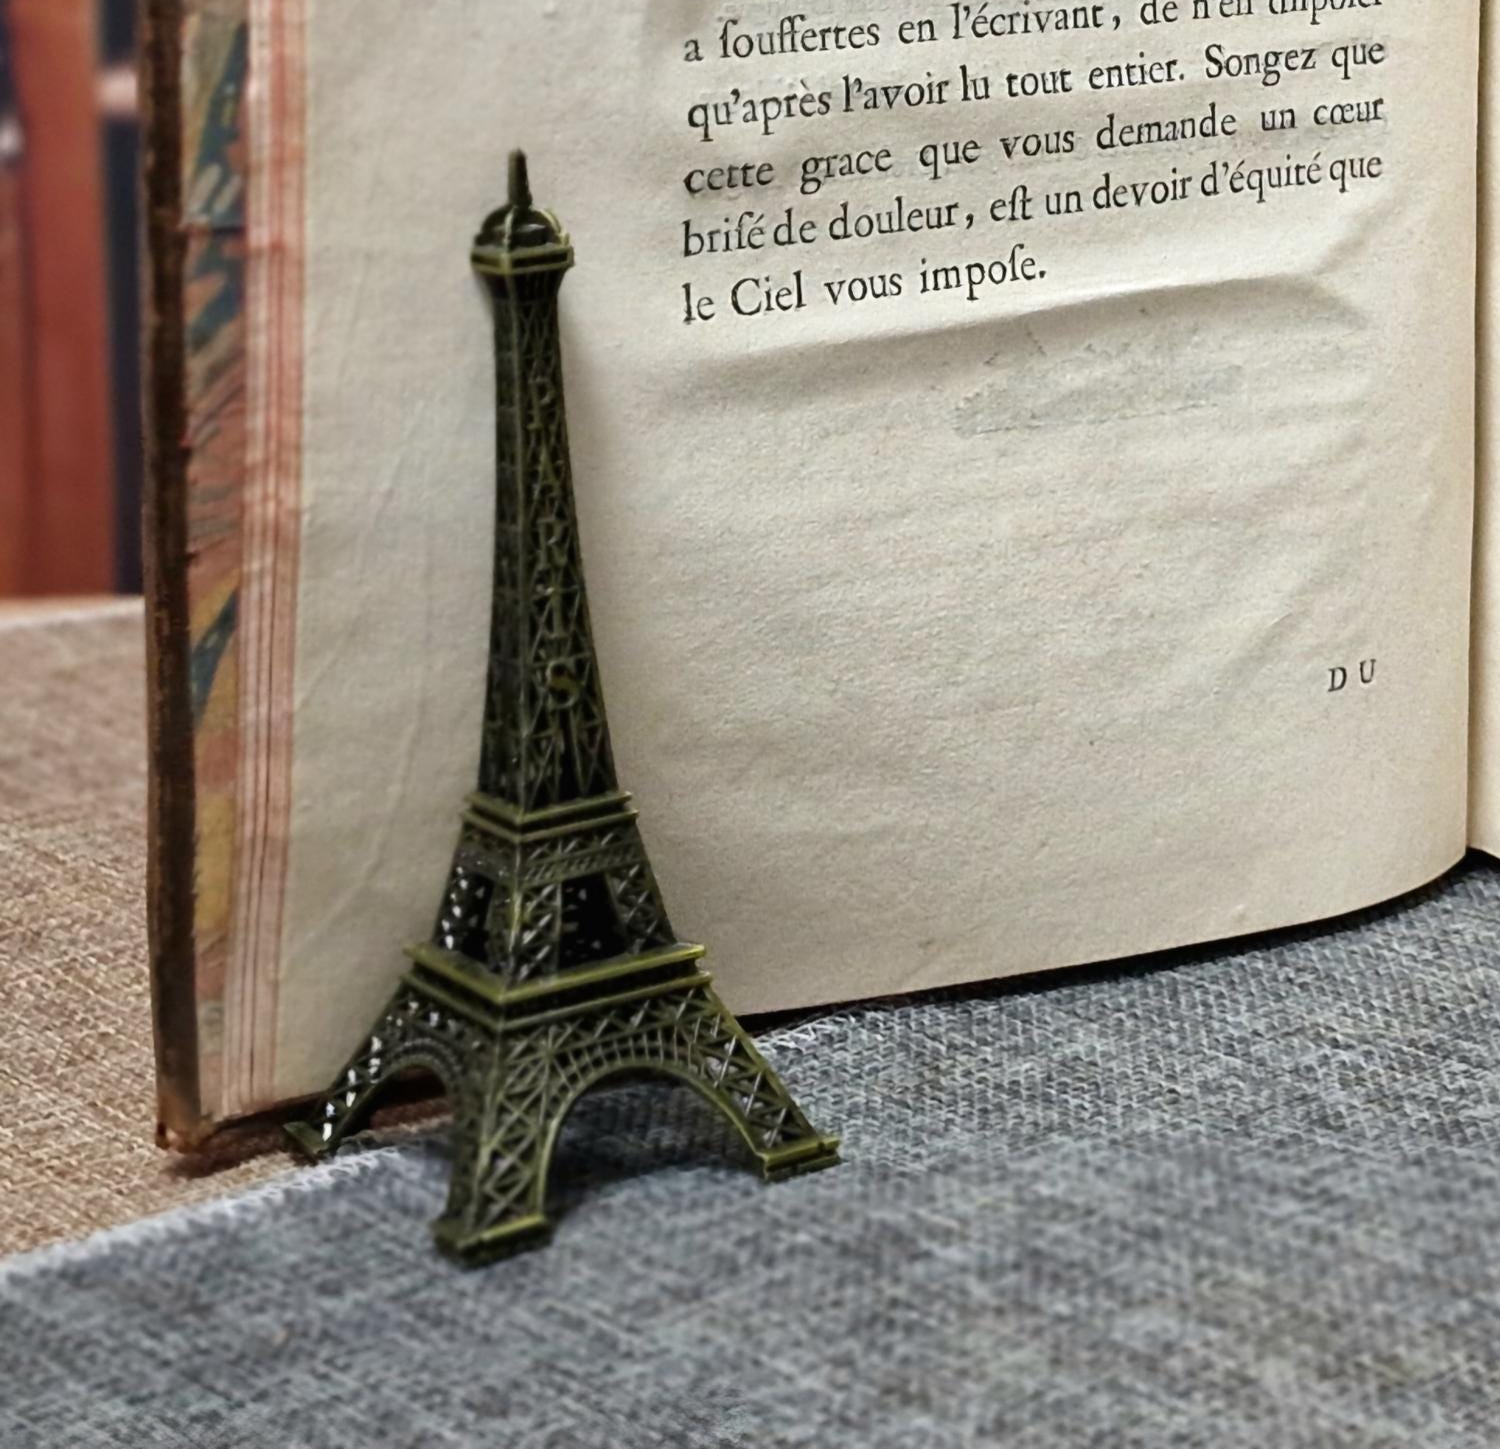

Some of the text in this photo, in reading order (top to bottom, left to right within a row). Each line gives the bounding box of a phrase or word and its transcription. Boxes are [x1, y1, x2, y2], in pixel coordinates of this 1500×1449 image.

[683, 39, 704, 63] a
[897, 18, 939, 45] en
[687, 42, 1385, 143] qu'après l'avoir lu tout entier. Songez que
[682, 162, 774, 198] cette
[799, 148, 894, 196] grace
[918, 139, 983, 181] que
[999, 130, 1075, 160] vous
[1096, 101, 1238, 151] demande
[1260, 108, 1298, 132] un
[773, 207, 817, 247] de
[1045, 190, 1084, 216] un
[1092, 166, 1193, 210] devoir
[1200, 151, 1322, 204] d'équité
[1329, 156, 1383, 194] que
[681, 282, 716, 326] le
[730, 269, 807, 317] Ciel
[823, 272, 903, 306] vous
